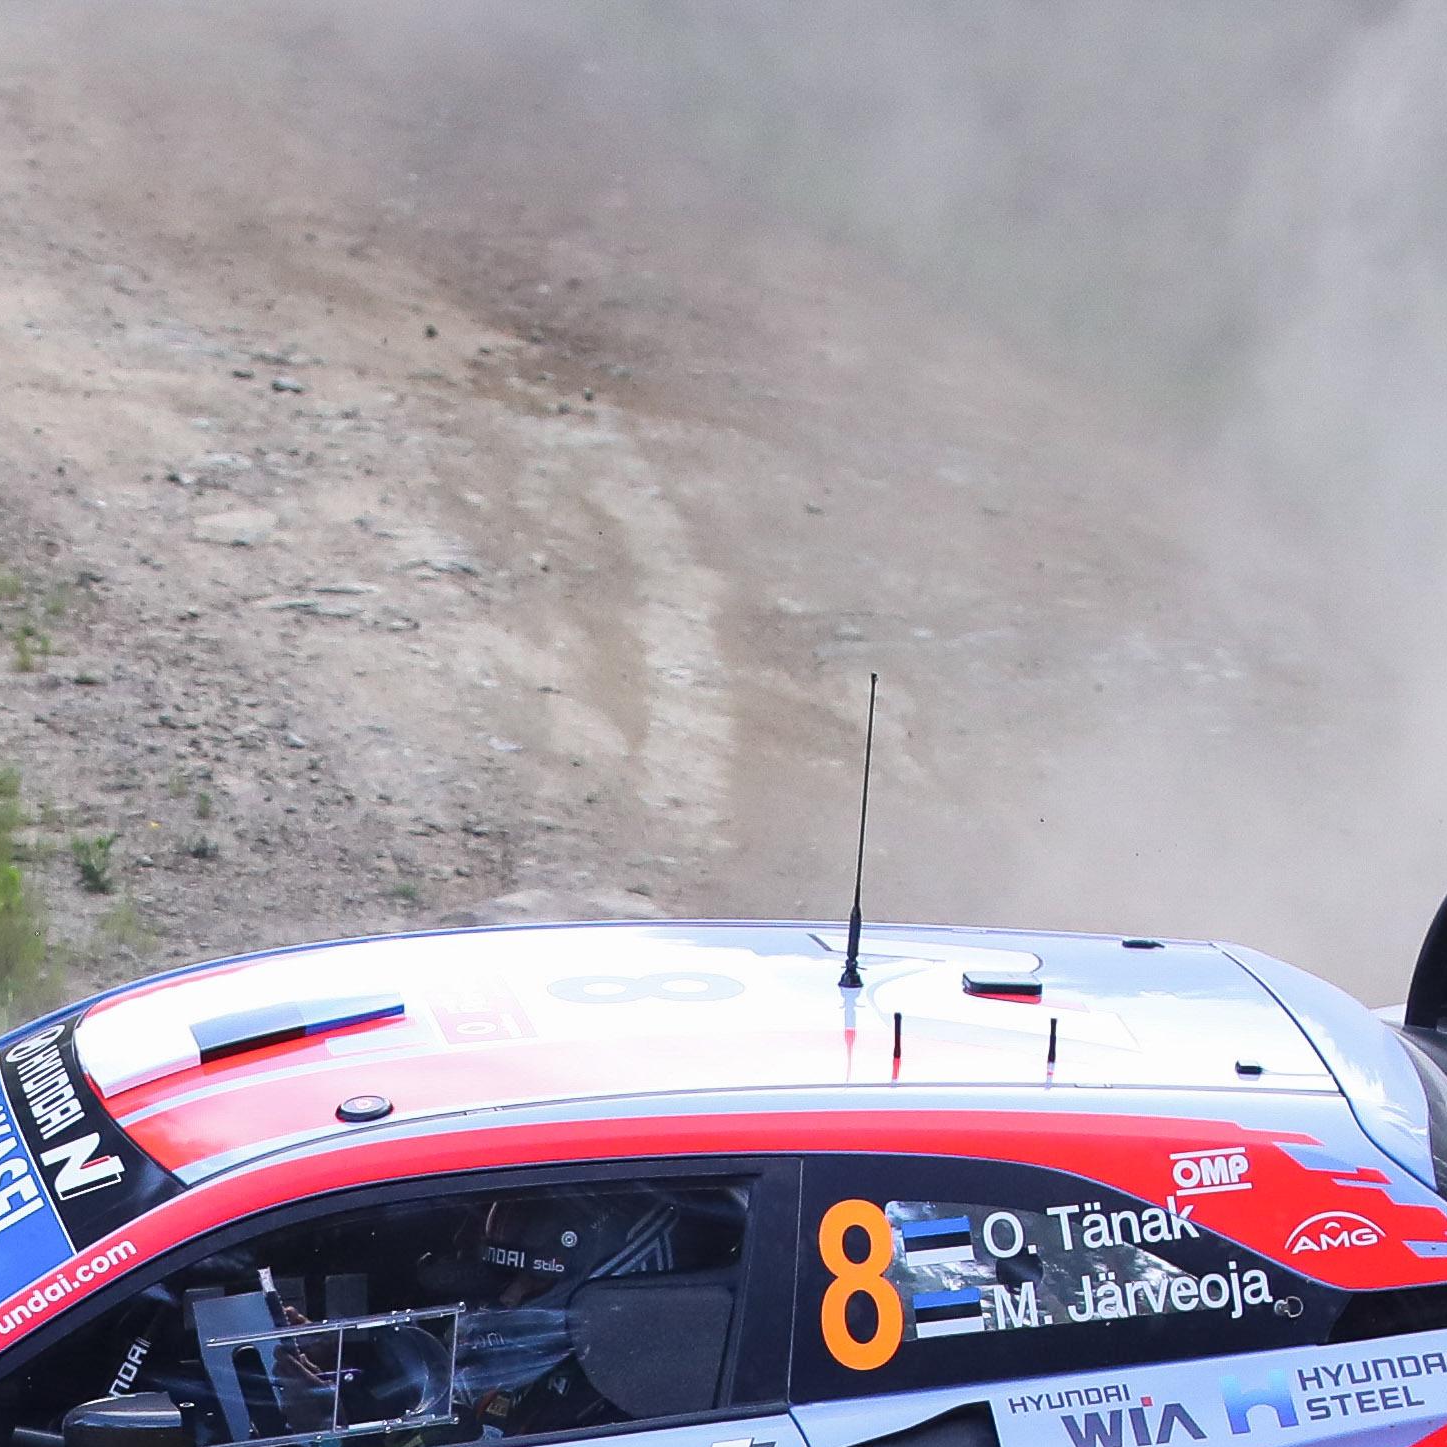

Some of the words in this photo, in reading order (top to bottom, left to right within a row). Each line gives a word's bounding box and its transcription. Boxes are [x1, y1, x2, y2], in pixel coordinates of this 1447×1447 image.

[17, 1044, 85, 1140] HYUNDAI
[1173, 1154, 1250, 1188] OMP
[983, 1211, 1037, 1259] O.
[1048, 1195, 1201, 1248] Tänak
[1291, 1229, 1378, 1254] AMG
[819, 1199, 904, 1371] 8
[994, 1281, 1053, 1330] M.
[1067, 1261, 1273, 1322] Järveoja
[1009, 1383, 1131, 1415] HYUNDAI
[1307, 1386, 1426, 1421] STEEL
